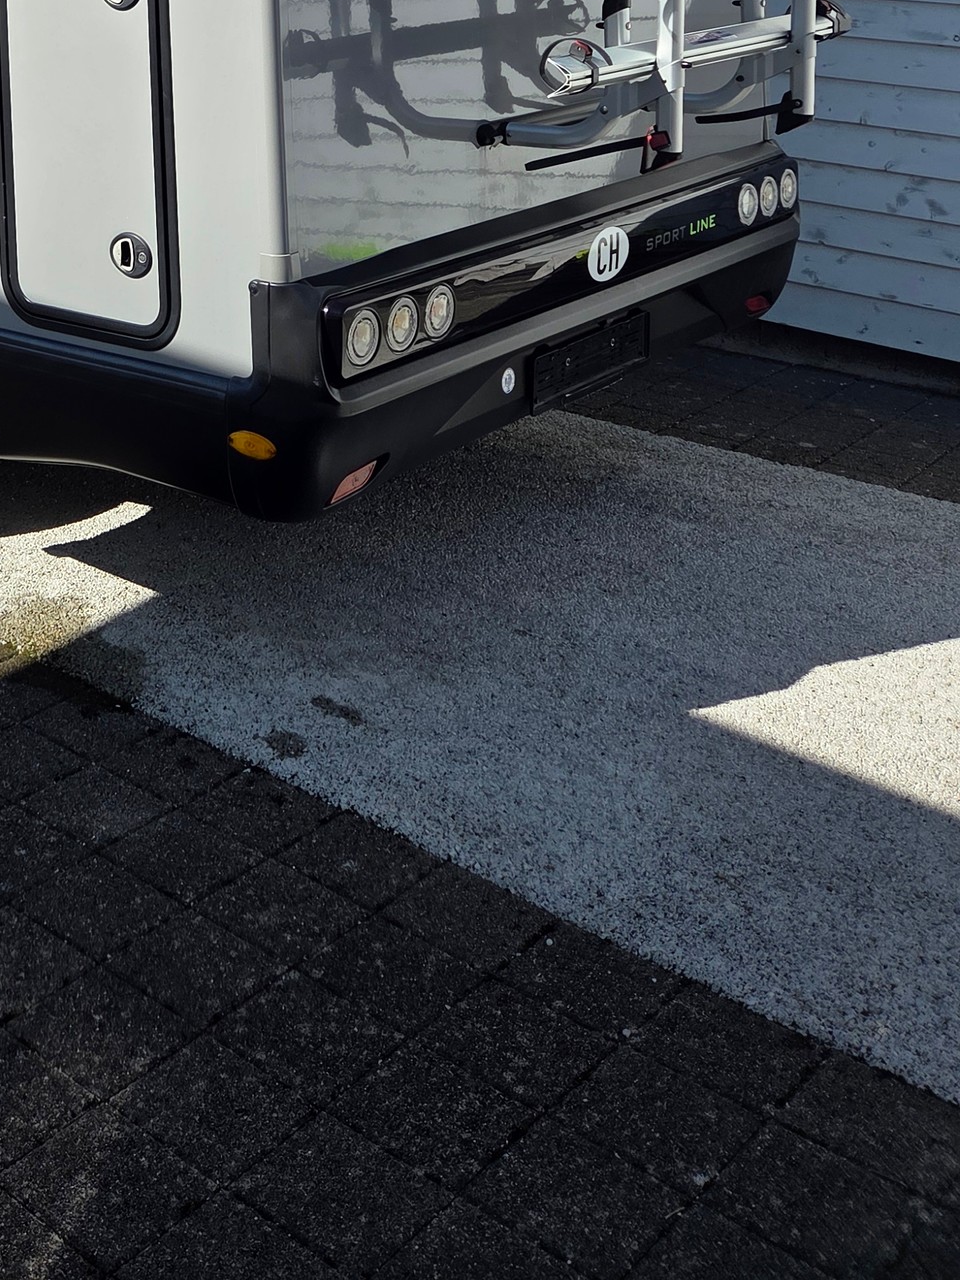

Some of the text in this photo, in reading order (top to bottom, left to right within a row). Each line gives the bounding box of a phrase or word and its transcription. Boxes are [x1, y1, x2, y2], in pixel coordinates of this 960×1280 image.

[596, 231, 620, 276] CH
[645, 214, 716, 252] SPORT LINE
